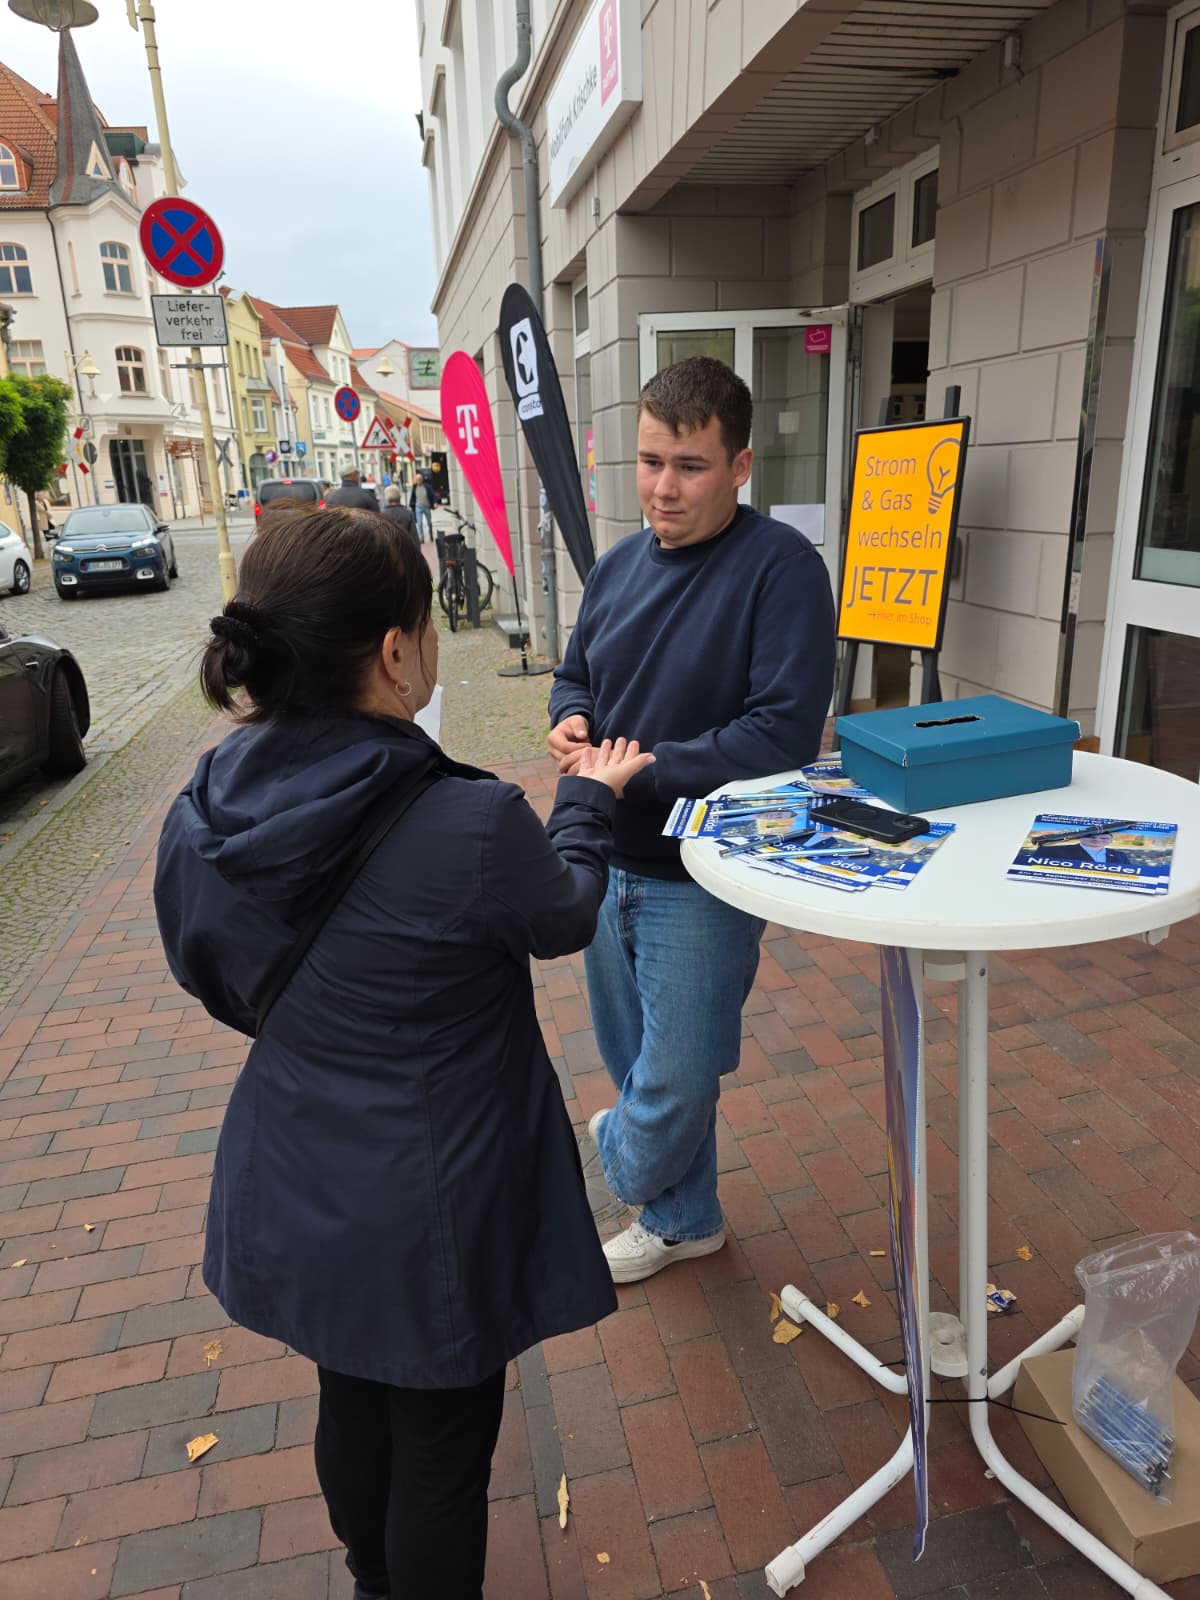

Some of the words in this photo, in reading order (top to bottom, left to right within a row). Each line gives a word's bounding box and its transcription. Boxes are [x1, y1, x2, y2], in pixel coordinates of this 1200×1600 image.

[573, 64, 598, 122] Krischke
[167, 300, 211, 312] Liefer-
[166, 315, 214, 326] verkehr
[181, 328, 203, 341] frei
[456, 404, 480, 455] T
[865, 455, 917, 477] Strom
[861, 490, 873, 511] &
[880, 489, 913, 511] Gas
[858, 523, 943, 549] wechseln
[846, 566, 938, 609] JETZT
[909, 614, 932, 627] Shop
[830, 859, 870, 872] ödel
[1027, 857, 1073, 867] Nico
[1080, 862, 1142, 875] Rödel
